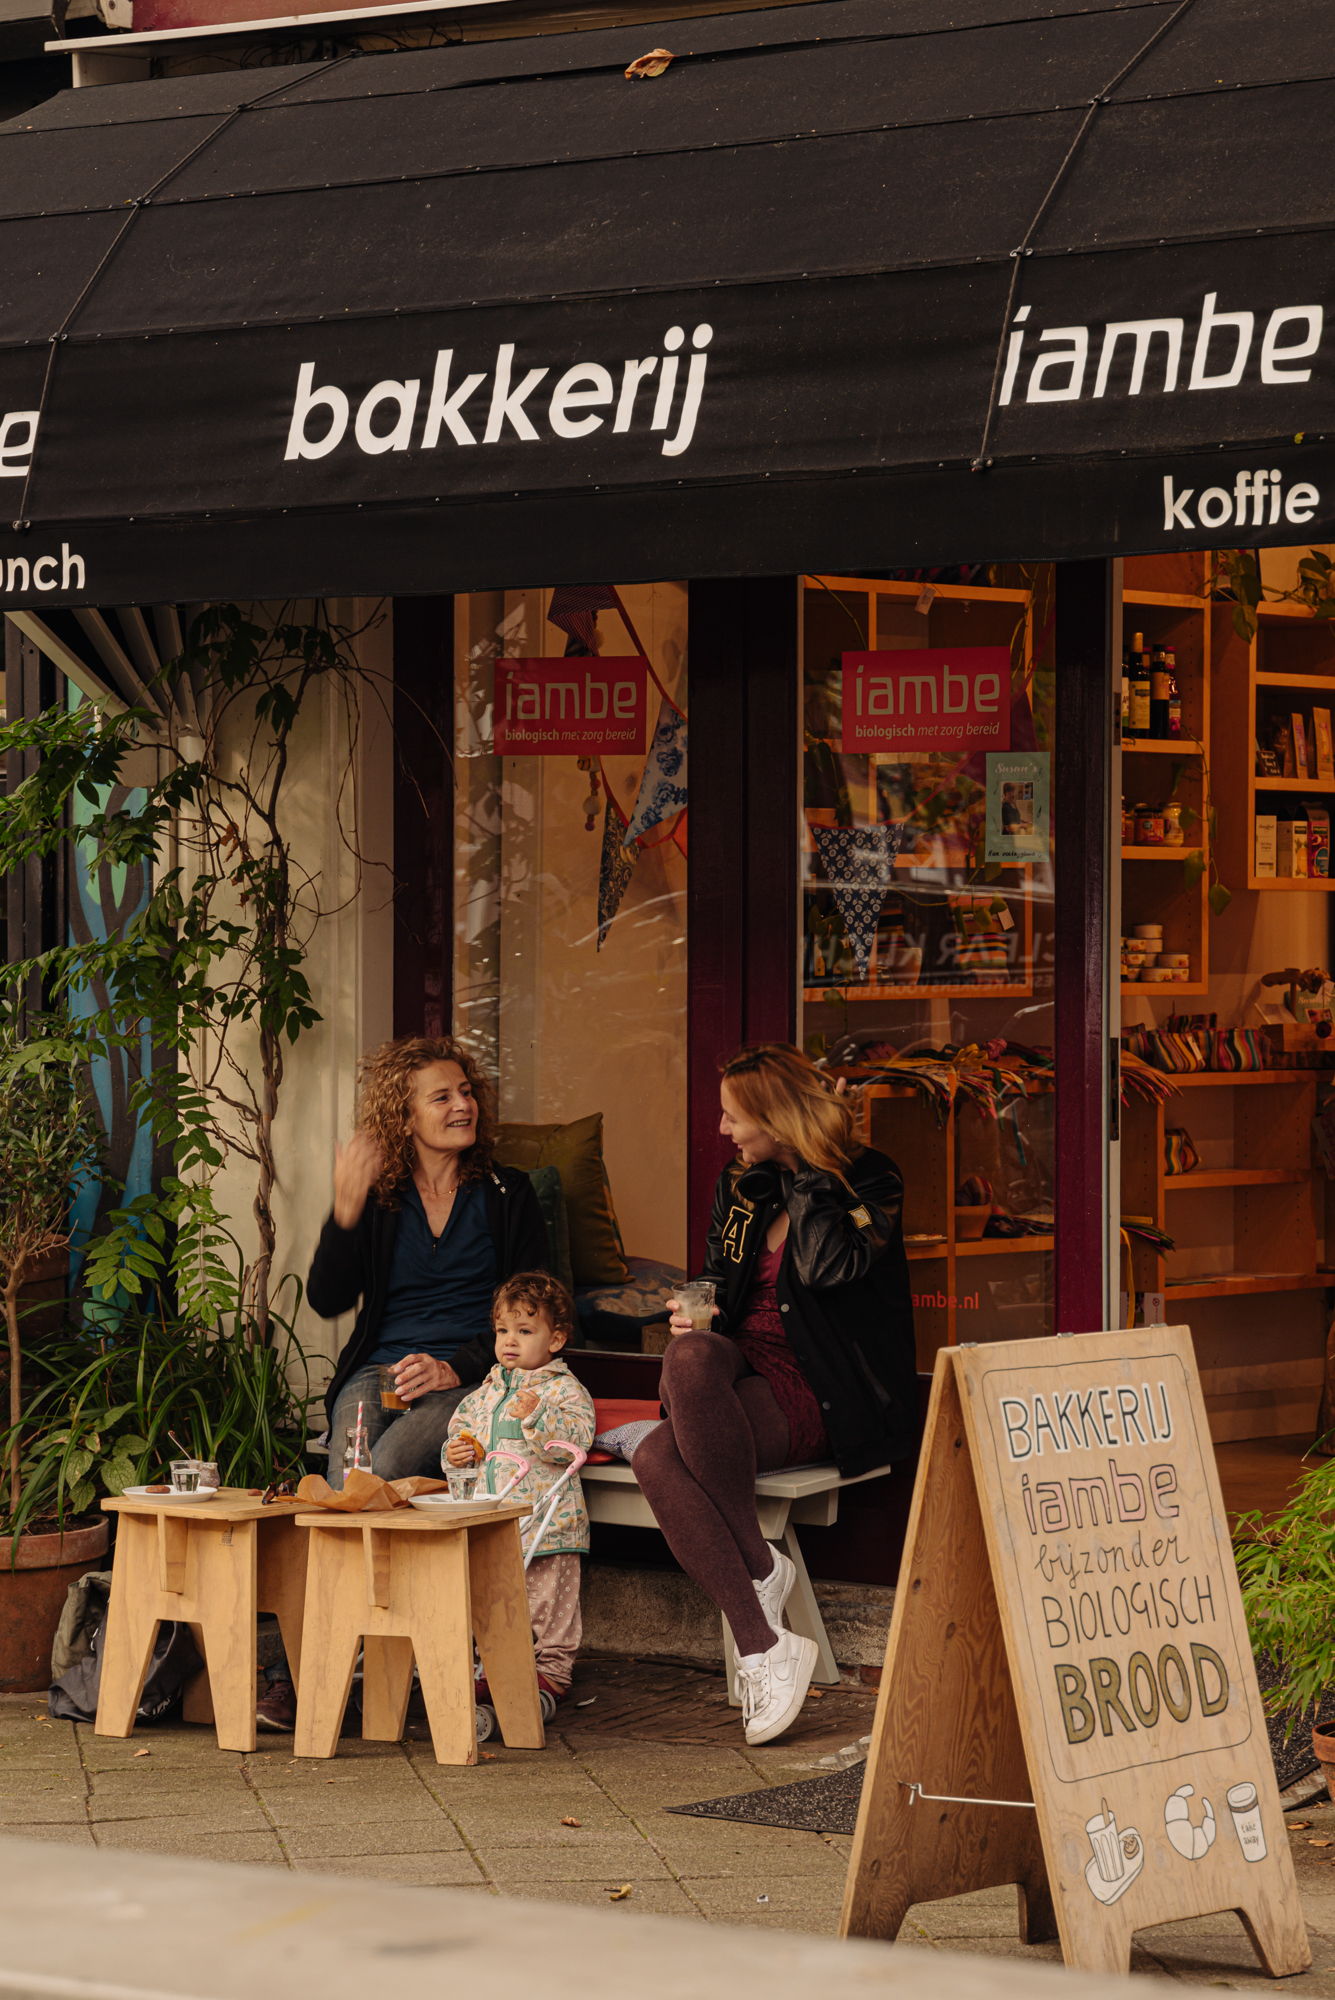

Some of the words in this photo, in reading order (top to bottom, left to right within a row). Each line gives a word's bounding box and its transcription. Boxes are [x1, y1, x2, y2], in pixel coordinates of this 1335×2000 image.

[999, 291, 1324, 407] iambe
[284, 323, 714, 461] bakkerij
[1163, 468, 1321, 531] koffie
[505, 671, 637, 720] iambe
[856, 664, 1000, 716] iambe
[505, 728, 560, 744] biologisch
[561, 729, 581, 741] met
[581, 730, 604, 744] zorg
[605, 727, 637, 741] bereid
[855, 723, 915, 740] biologisch
[917, 724, 939, 737] met
[940, 725, 964, 739] zorg
[965, 721, 1000, 736] bereid
[721, 1204, 754, 1264] A
[911, 1290, 979, 1310] ambe.nl
[1001, 1383, 1173, 1460] BAKKERIJ
[1020, 1458, 1181, 1535] iambe
[1035, 1530, 1190, 1590] bijzonder
[1042, 1574, 1217, 1648] BIOLOGISCH
[1053, 1641, 1230, 1745] BROOD
[1241, 1821, 1256, 1833] take
[1242, 1835, 1259, 1846] away
